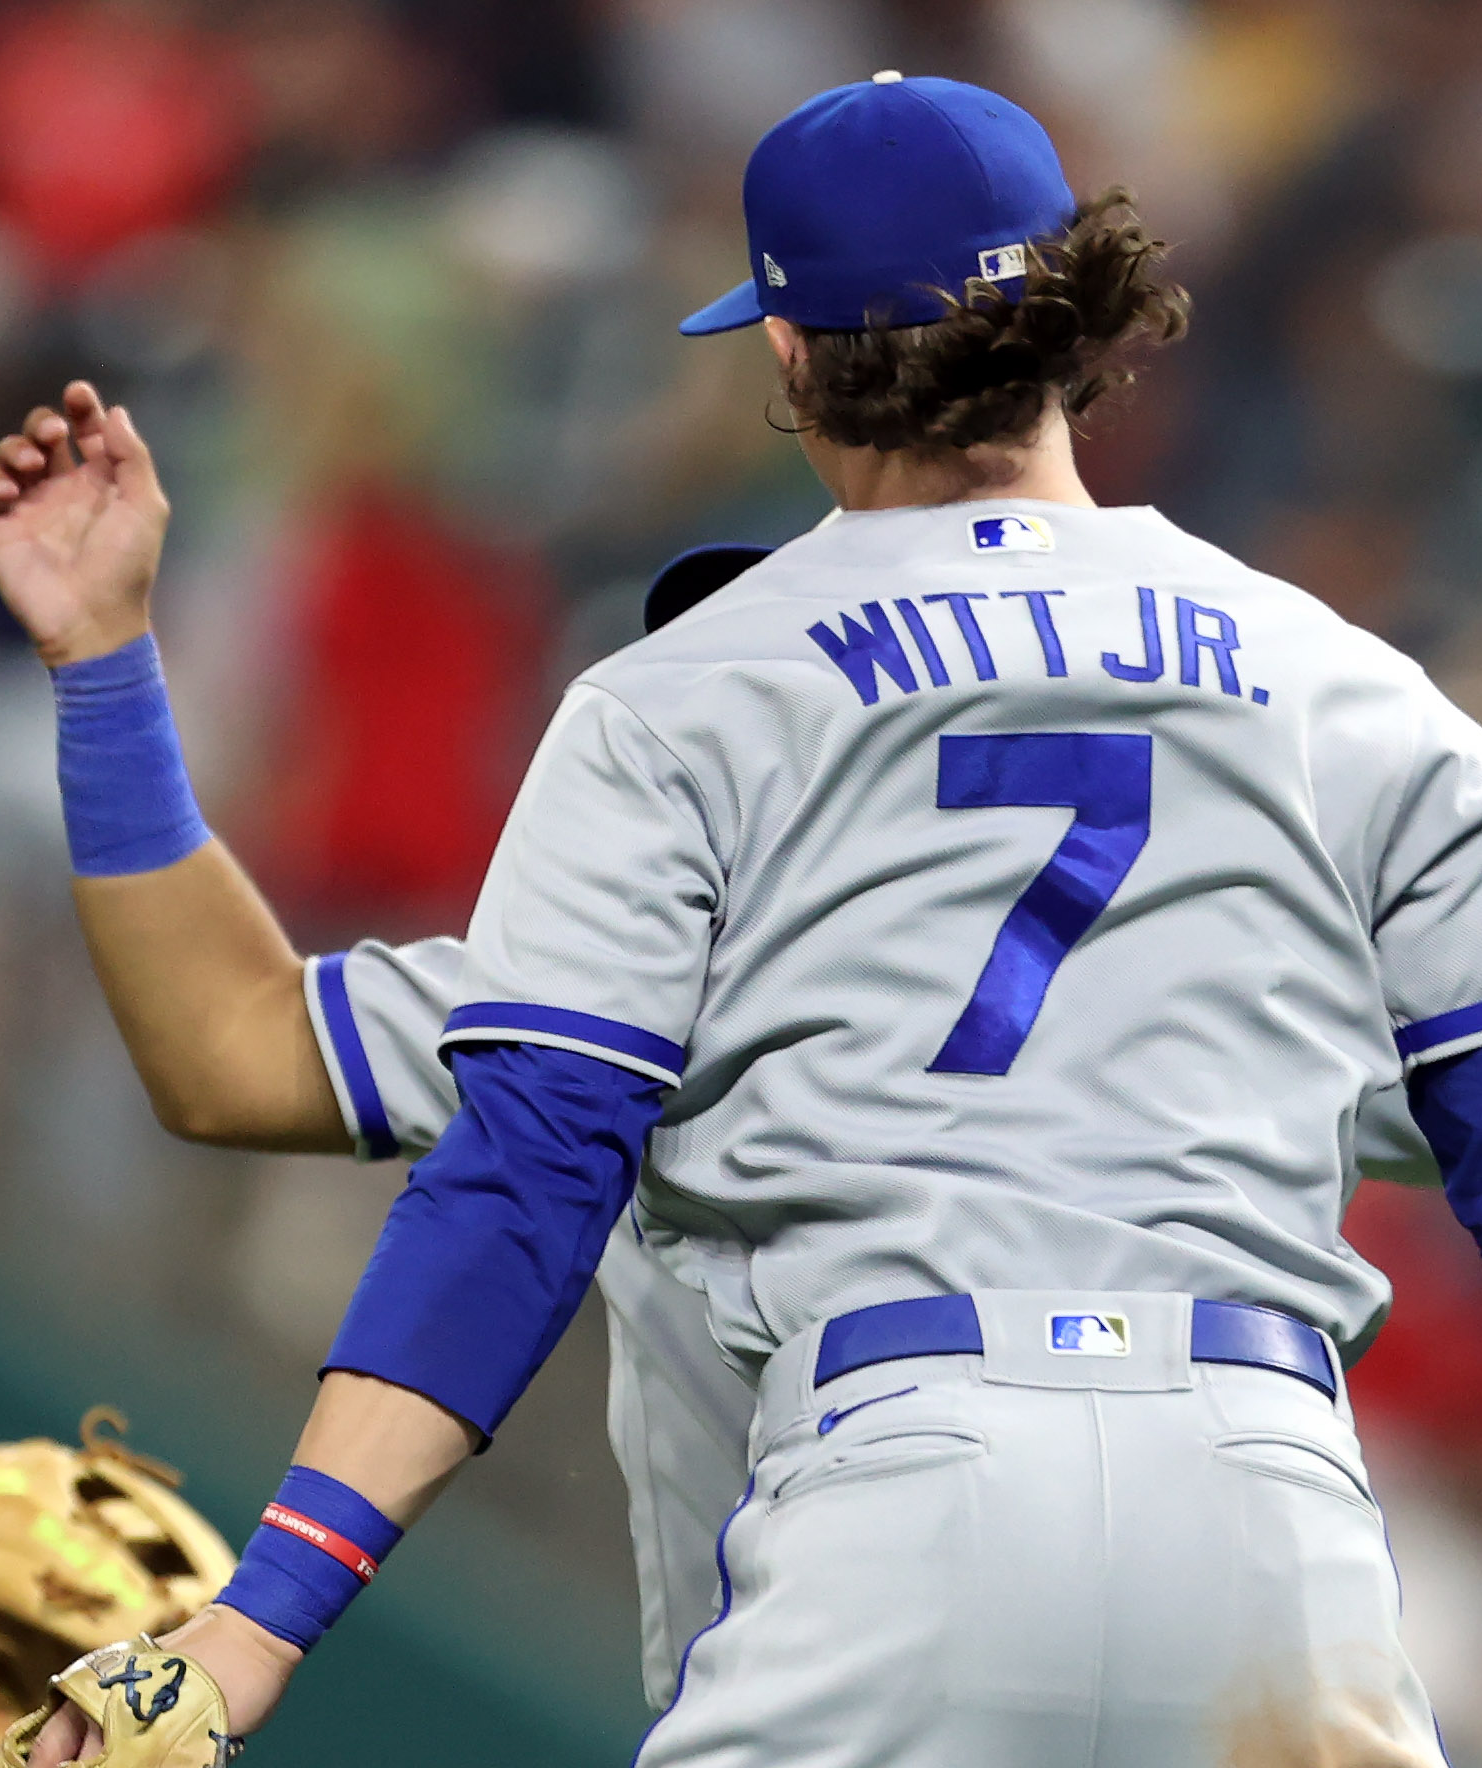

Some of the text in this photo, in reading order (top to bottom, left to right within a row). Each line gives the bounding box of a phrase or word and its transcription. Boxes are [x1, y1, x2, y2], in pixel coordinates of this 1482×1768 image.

[806, 586, 1270, 707] WITT JR.
[925, 732, 1153, 1076] 7
